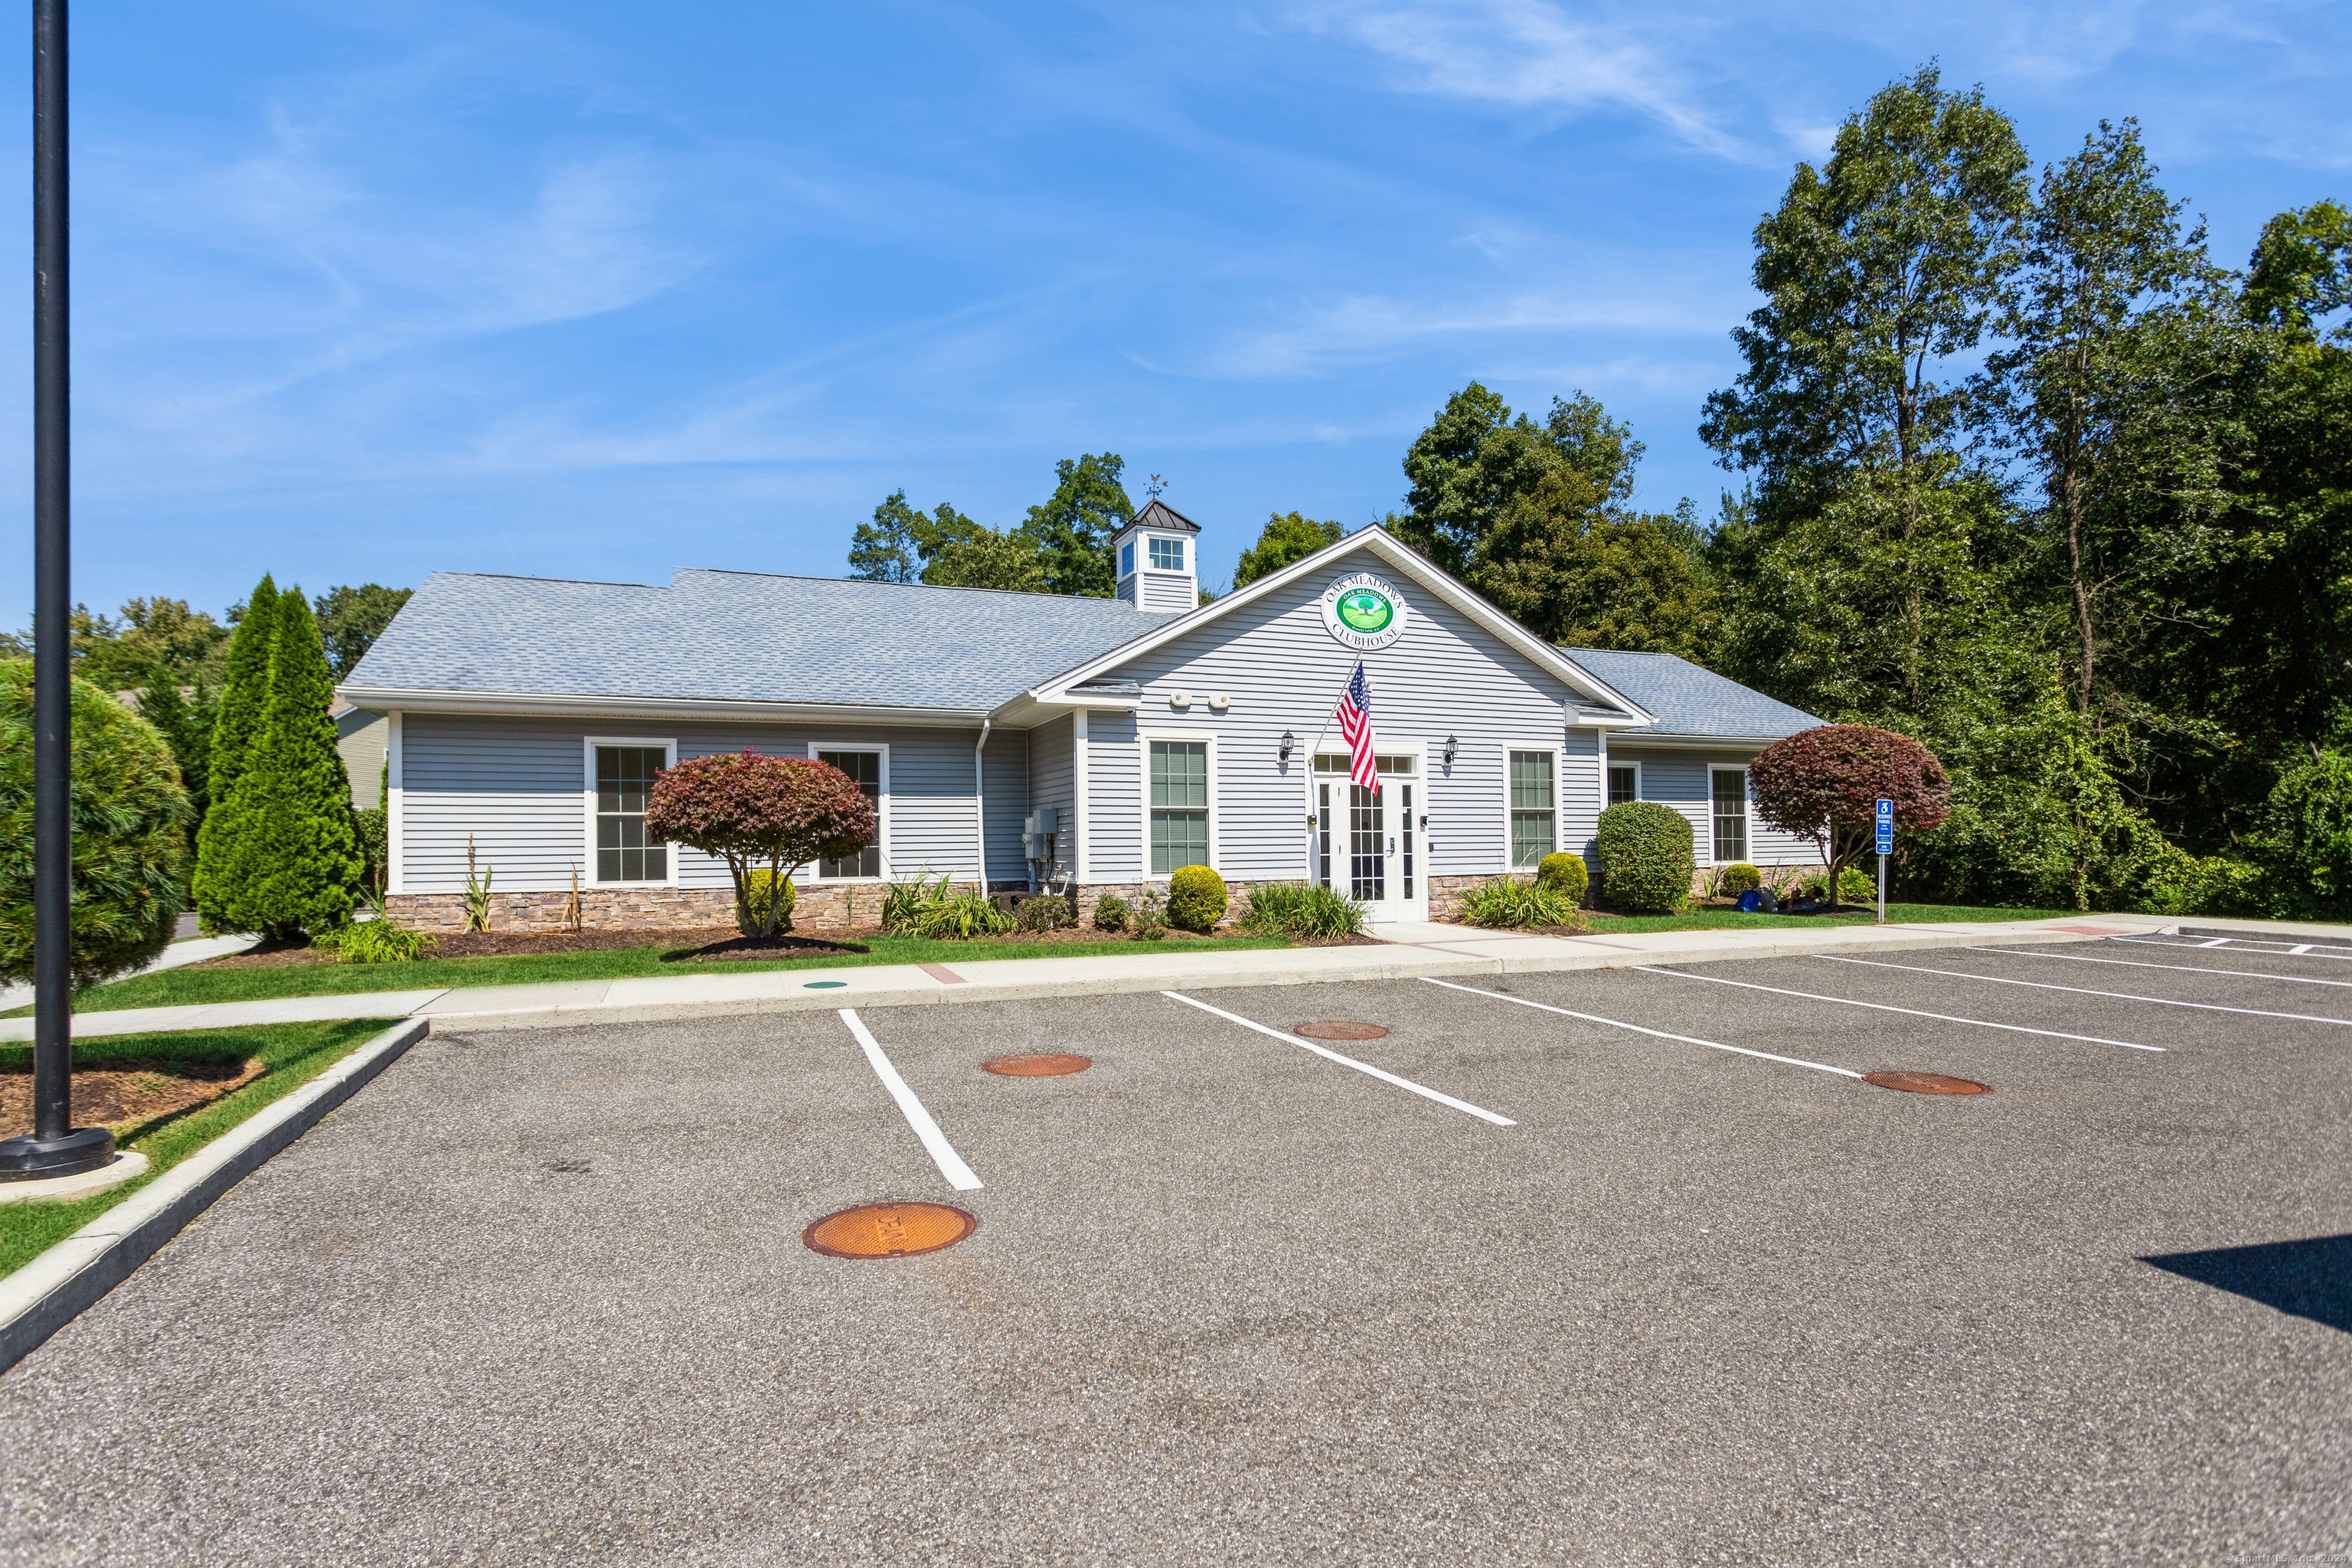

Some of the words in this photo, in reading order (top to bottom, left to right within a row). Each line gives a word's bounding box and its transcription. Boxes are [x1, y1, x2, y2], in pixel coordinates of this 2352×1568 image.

[1327, 580, 1347, 603] OAK
[1349, 576, 1403, 608] MEADOWS
[1344, 590, 1355, 599] OAK
[1357, 589, 1387, 603] MEADOWS
[1333, 624, 1399, 646] CLUBHOUSE
